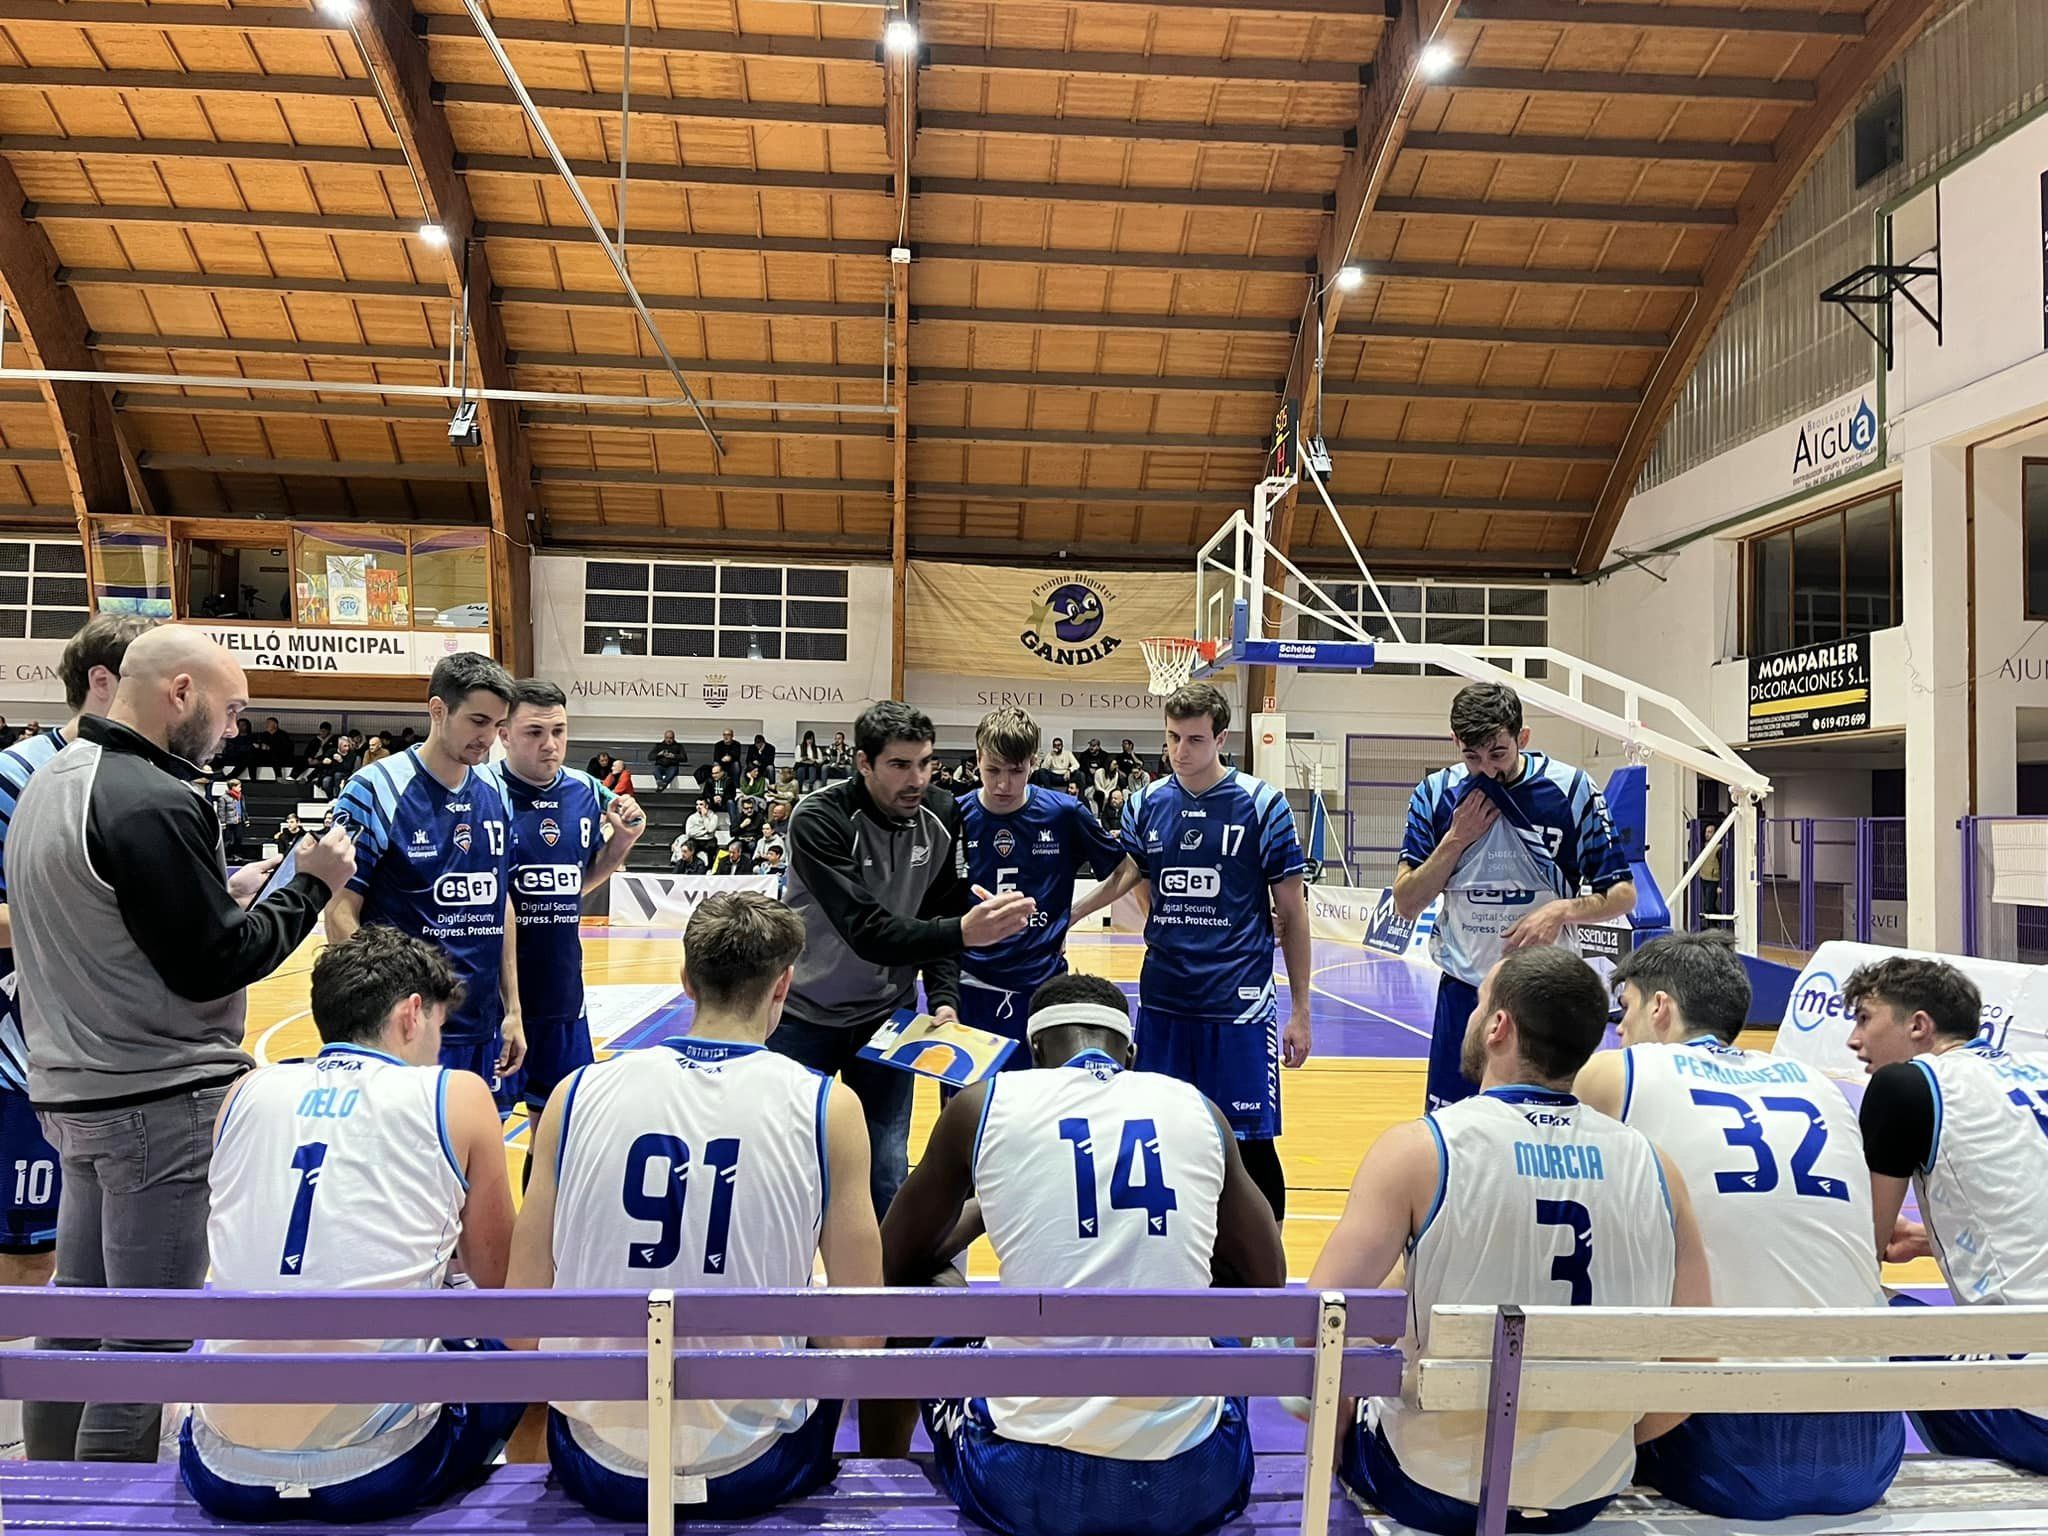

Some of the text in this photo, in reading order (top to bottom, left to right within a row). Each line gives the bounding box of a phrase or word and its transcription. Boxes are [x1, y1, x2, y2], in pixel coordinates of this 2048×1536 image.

[203, 631, 405, 655] VELLÓ MUNICIPAL
[1020, 630, 1122, 666] GANDIA
[16, 665, 58, 680] GAN
[255, 654, 338, 671] GANDIA
[1758, 642, 1859, 680] MOMPARLER
[570, 679, 844, 702] AJUNTAMENT DE GANDIA
[977, 691, 1043, 706] SERVEI
[1750, 665, 1869, 701] DECORACIONES S.L.
[1820, 717, 1835, 729] 619
[1835, 716, 1850, 728] 473
[1850, 712, 1866, 725] 699
[483, 820, 504, 856] 13
[579, 817, 591, 849] 8
[1221, 824, 1245, 857] 17
[438, 913, 495, 925] Digital Security
[1184, 903, 1217, 915] Security
[1184, 916, 1232, 927] Protected.
[1316, 902, 1351, 920] SERVEI
[422, 925, 467, 939] Progress.
[1577, 927, 1618, 946] ssencia
[1514, 1141, 1605, 1180] MURCIA
[1689, 1088, 1851, 1202] 32
[13, 1158, 54, 1206] 10
[1058, 1117, 1178, 1239] 14
[279, 1140, 328, 1276] 1
[622, 1132, 741, 1275] 91
[1535, 1199, 1593, 1305] 3
